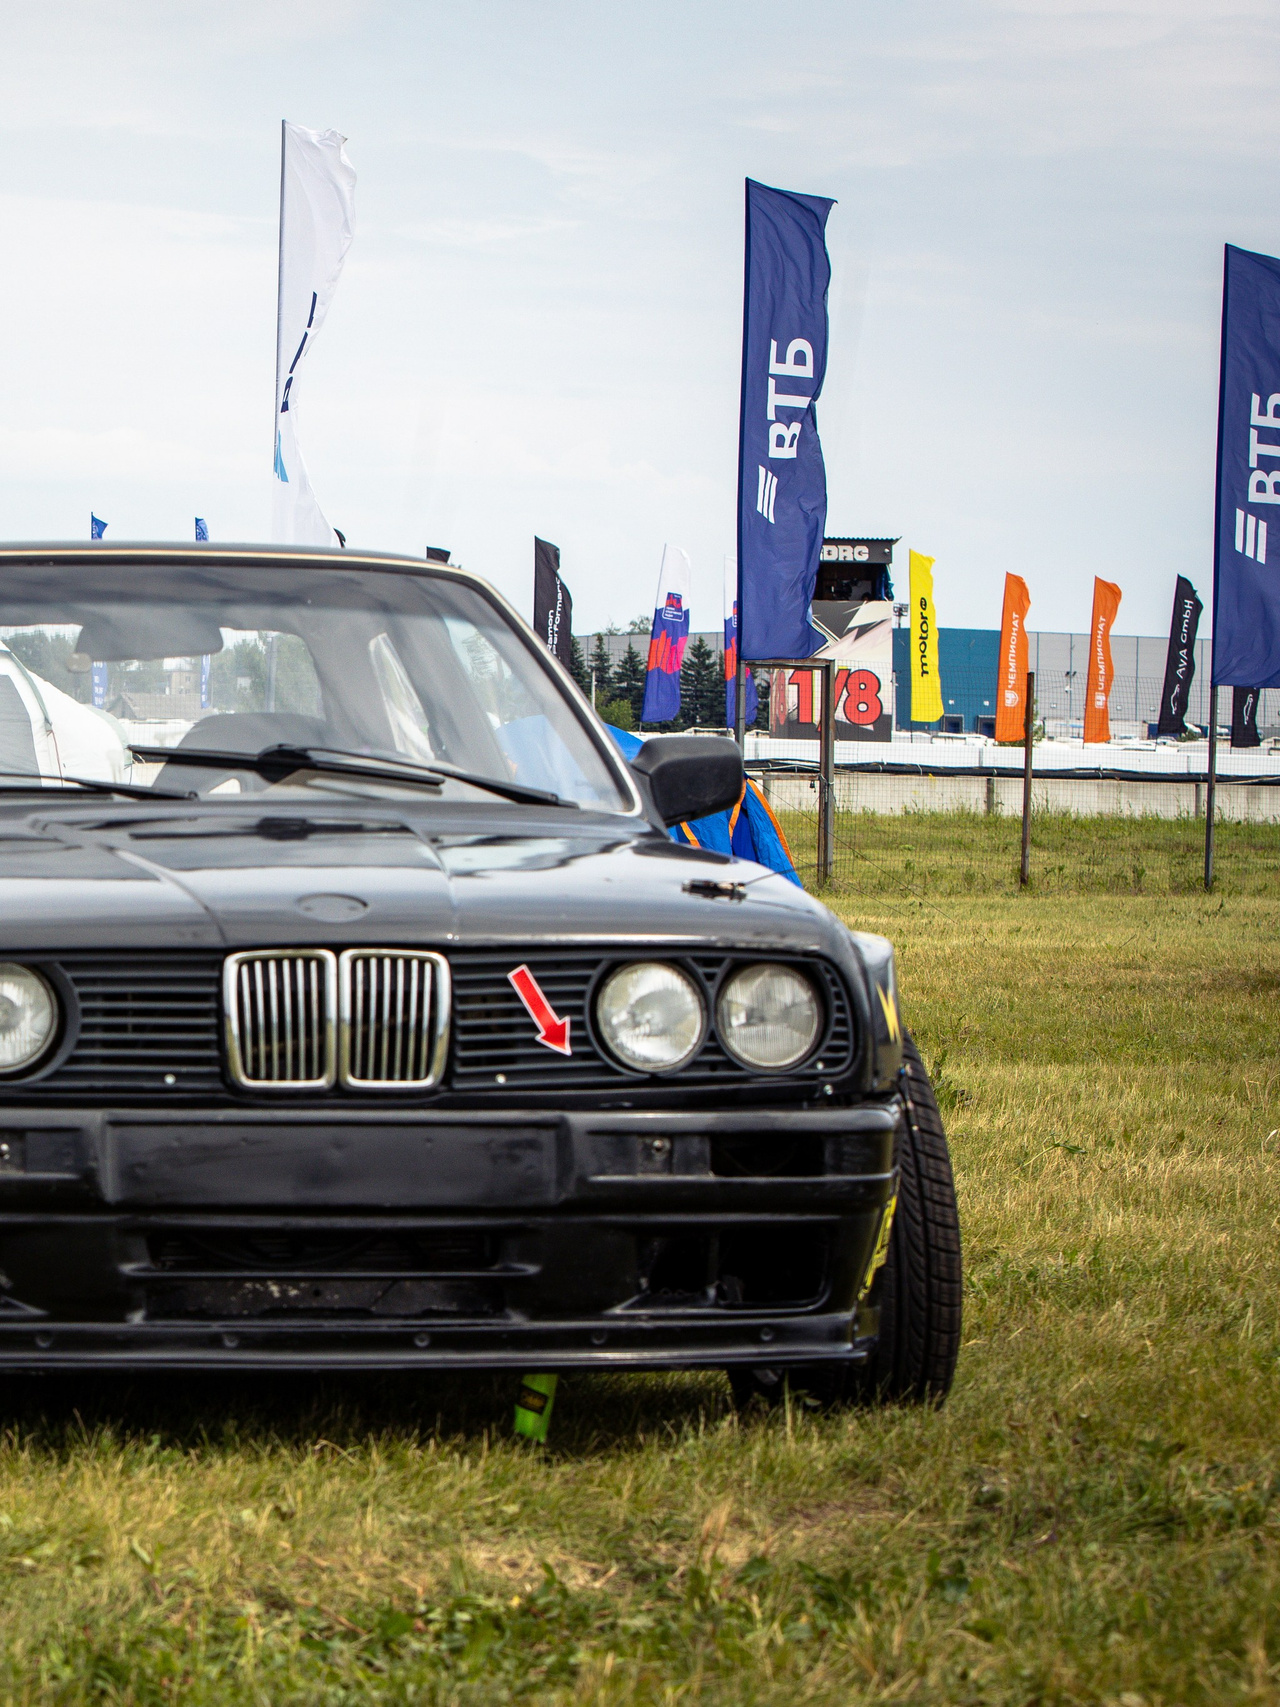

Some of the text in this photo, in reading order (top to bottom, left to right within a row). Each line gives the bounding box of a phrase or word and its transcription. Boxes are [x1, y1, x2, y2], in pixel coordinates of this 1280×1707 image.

[767, 337, 814, 460] ВТБ
[1248, 392, 1280, 505] ВТБ
[820, 544, 870, 561] DRC
[1008, 611, 1019, 689] ЧЕМПИОНАТ
[1097, 615, 1107, 691] ЧЕМПИОНАТ
[1176, 599, 1194, 679] AVA GmbH
